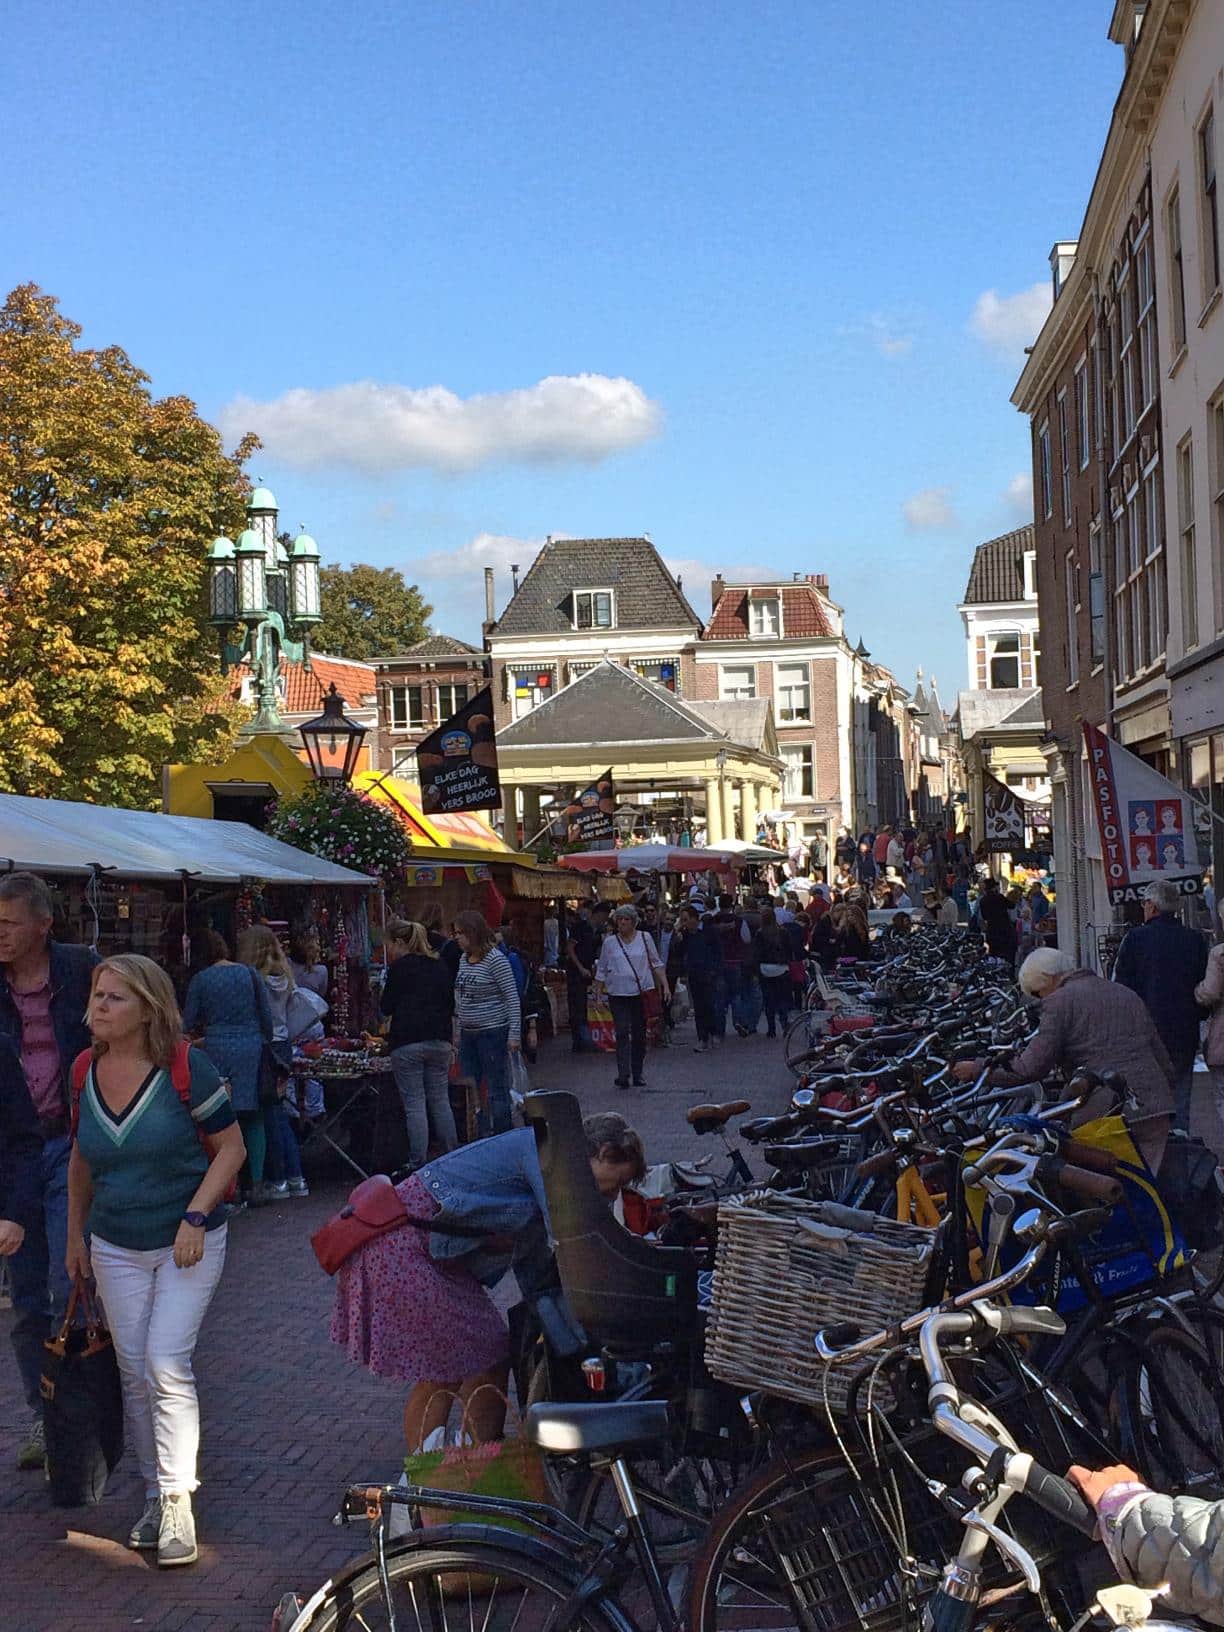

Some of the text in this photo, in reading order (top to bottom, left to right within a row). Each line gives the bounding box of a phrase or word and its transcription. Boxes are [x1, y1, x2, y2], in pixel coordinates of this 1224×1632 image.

[434, 765, 480, 785] ELKE DAG
[447, 775, 489, 795] HEERLIJK
[441, 788, 497, 810] VERS BROOD
[1093, 749, 1123, 878] PASFOTO
[1112, 879, 1198, 904] PASTO
